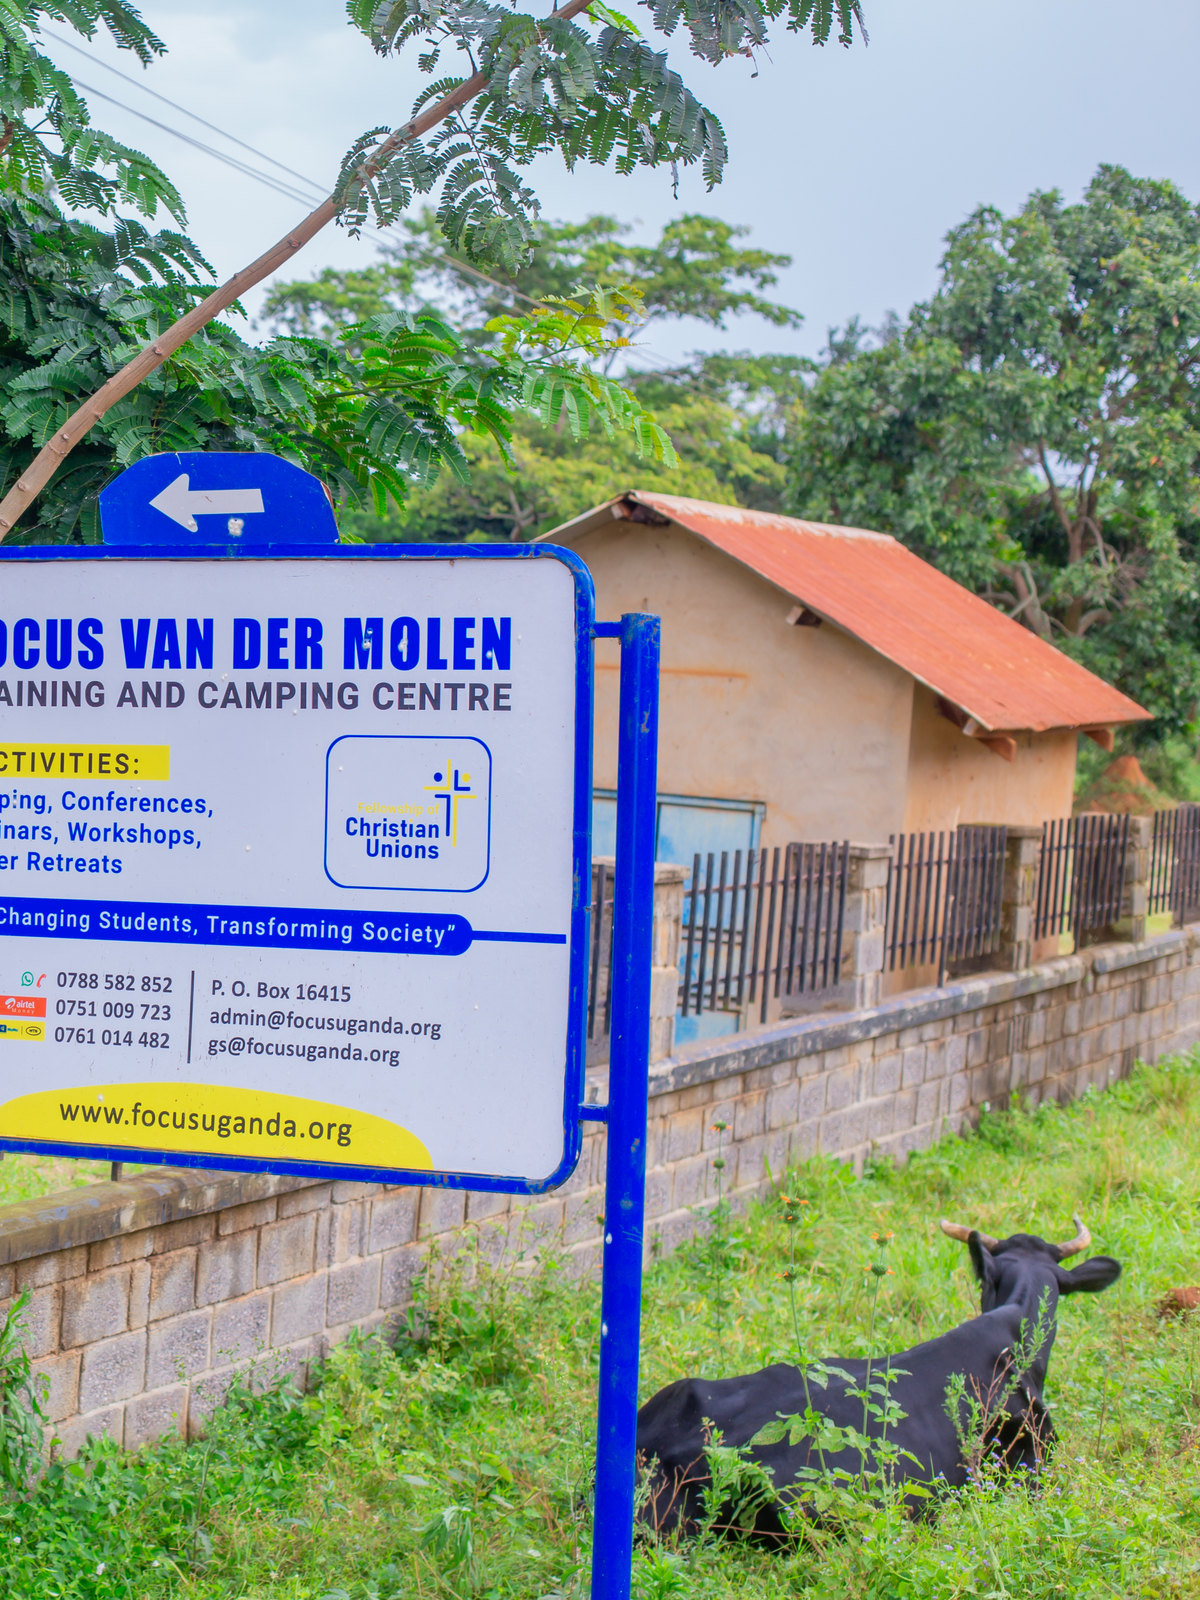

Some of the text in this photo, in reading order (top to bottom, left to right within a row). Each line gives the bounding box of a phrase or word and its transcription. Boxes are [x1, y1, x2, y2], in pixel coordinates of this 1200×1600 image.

[120, 618, 214, 669] VAN
[233, 618, 324, 669] DER
[343, 616, 512, 671] MOLEN
[116, 681, 185, 708] AND
[198, 681, 359, 710] CAMPING
[372, 682, 512, 711] CENTRE
[61, 791, 214, 818] Conferences,
[357, 802, 440, 817] Fellowship of
[67, 822, 201, 850] Workshops,
[345, 816, 440, 839] Christian
[366, 838, 440, 860] Unions
[27, 852, 123, 874] Retreats
[99, 911, 199, 936] Students,
[207, 915, 353, 944] Transforming
[56, 972, 173, 993] 0788 582 852
[211, 979, 352, 1003] P. O. Box 16415
[16, 1000, 35, 1008] airtel
[55, 999, 172, 1021] 0751 009 723
[209, 1008, 442, 1041] admin@focusuganda.org
[54, 1027, 170, 1049] 0761 014 482
[207, 1036, 400, 1067] gs@focusuganda.org
[59, 1101, 353, 1146] www.focusuganda.org
